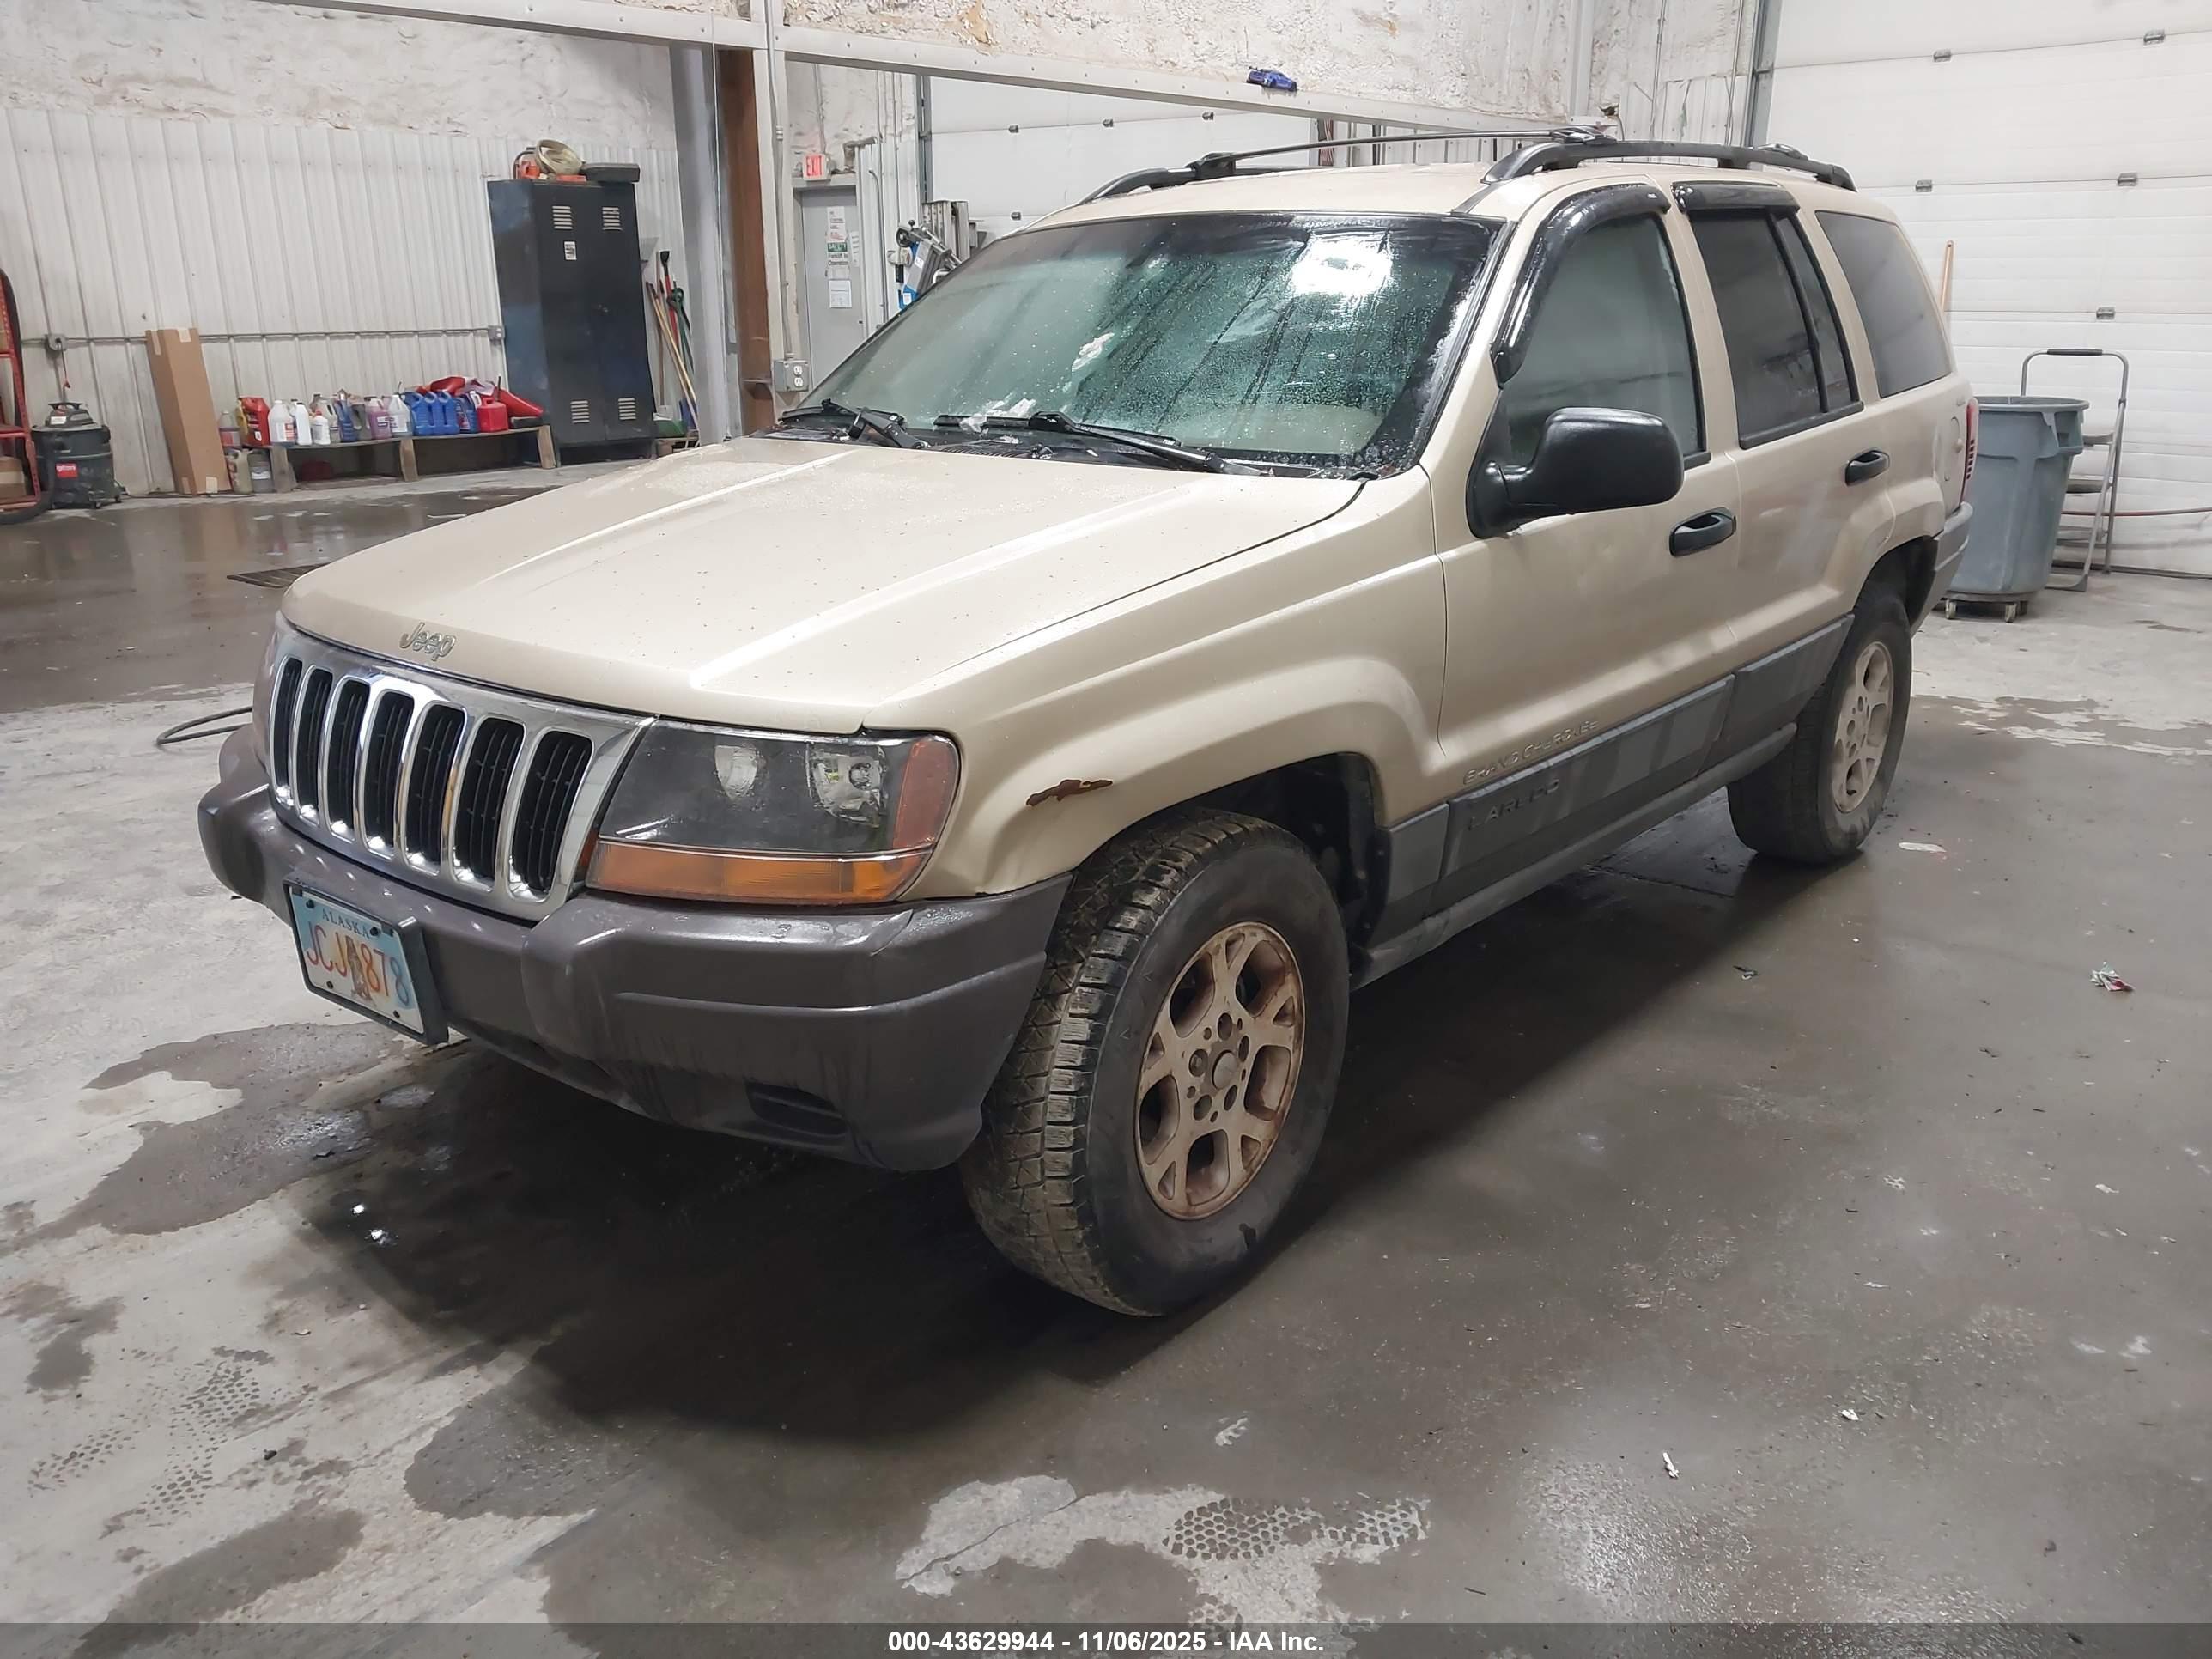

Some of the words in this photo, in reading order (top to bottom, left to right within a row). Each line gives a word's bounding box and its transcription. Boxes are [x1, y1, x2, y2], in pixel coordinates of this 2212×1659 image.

[805, 155, 823, 177] EXIT
[399, 621, 457, 662] Jeep
[322, 908, 370, 939] ALASKA
